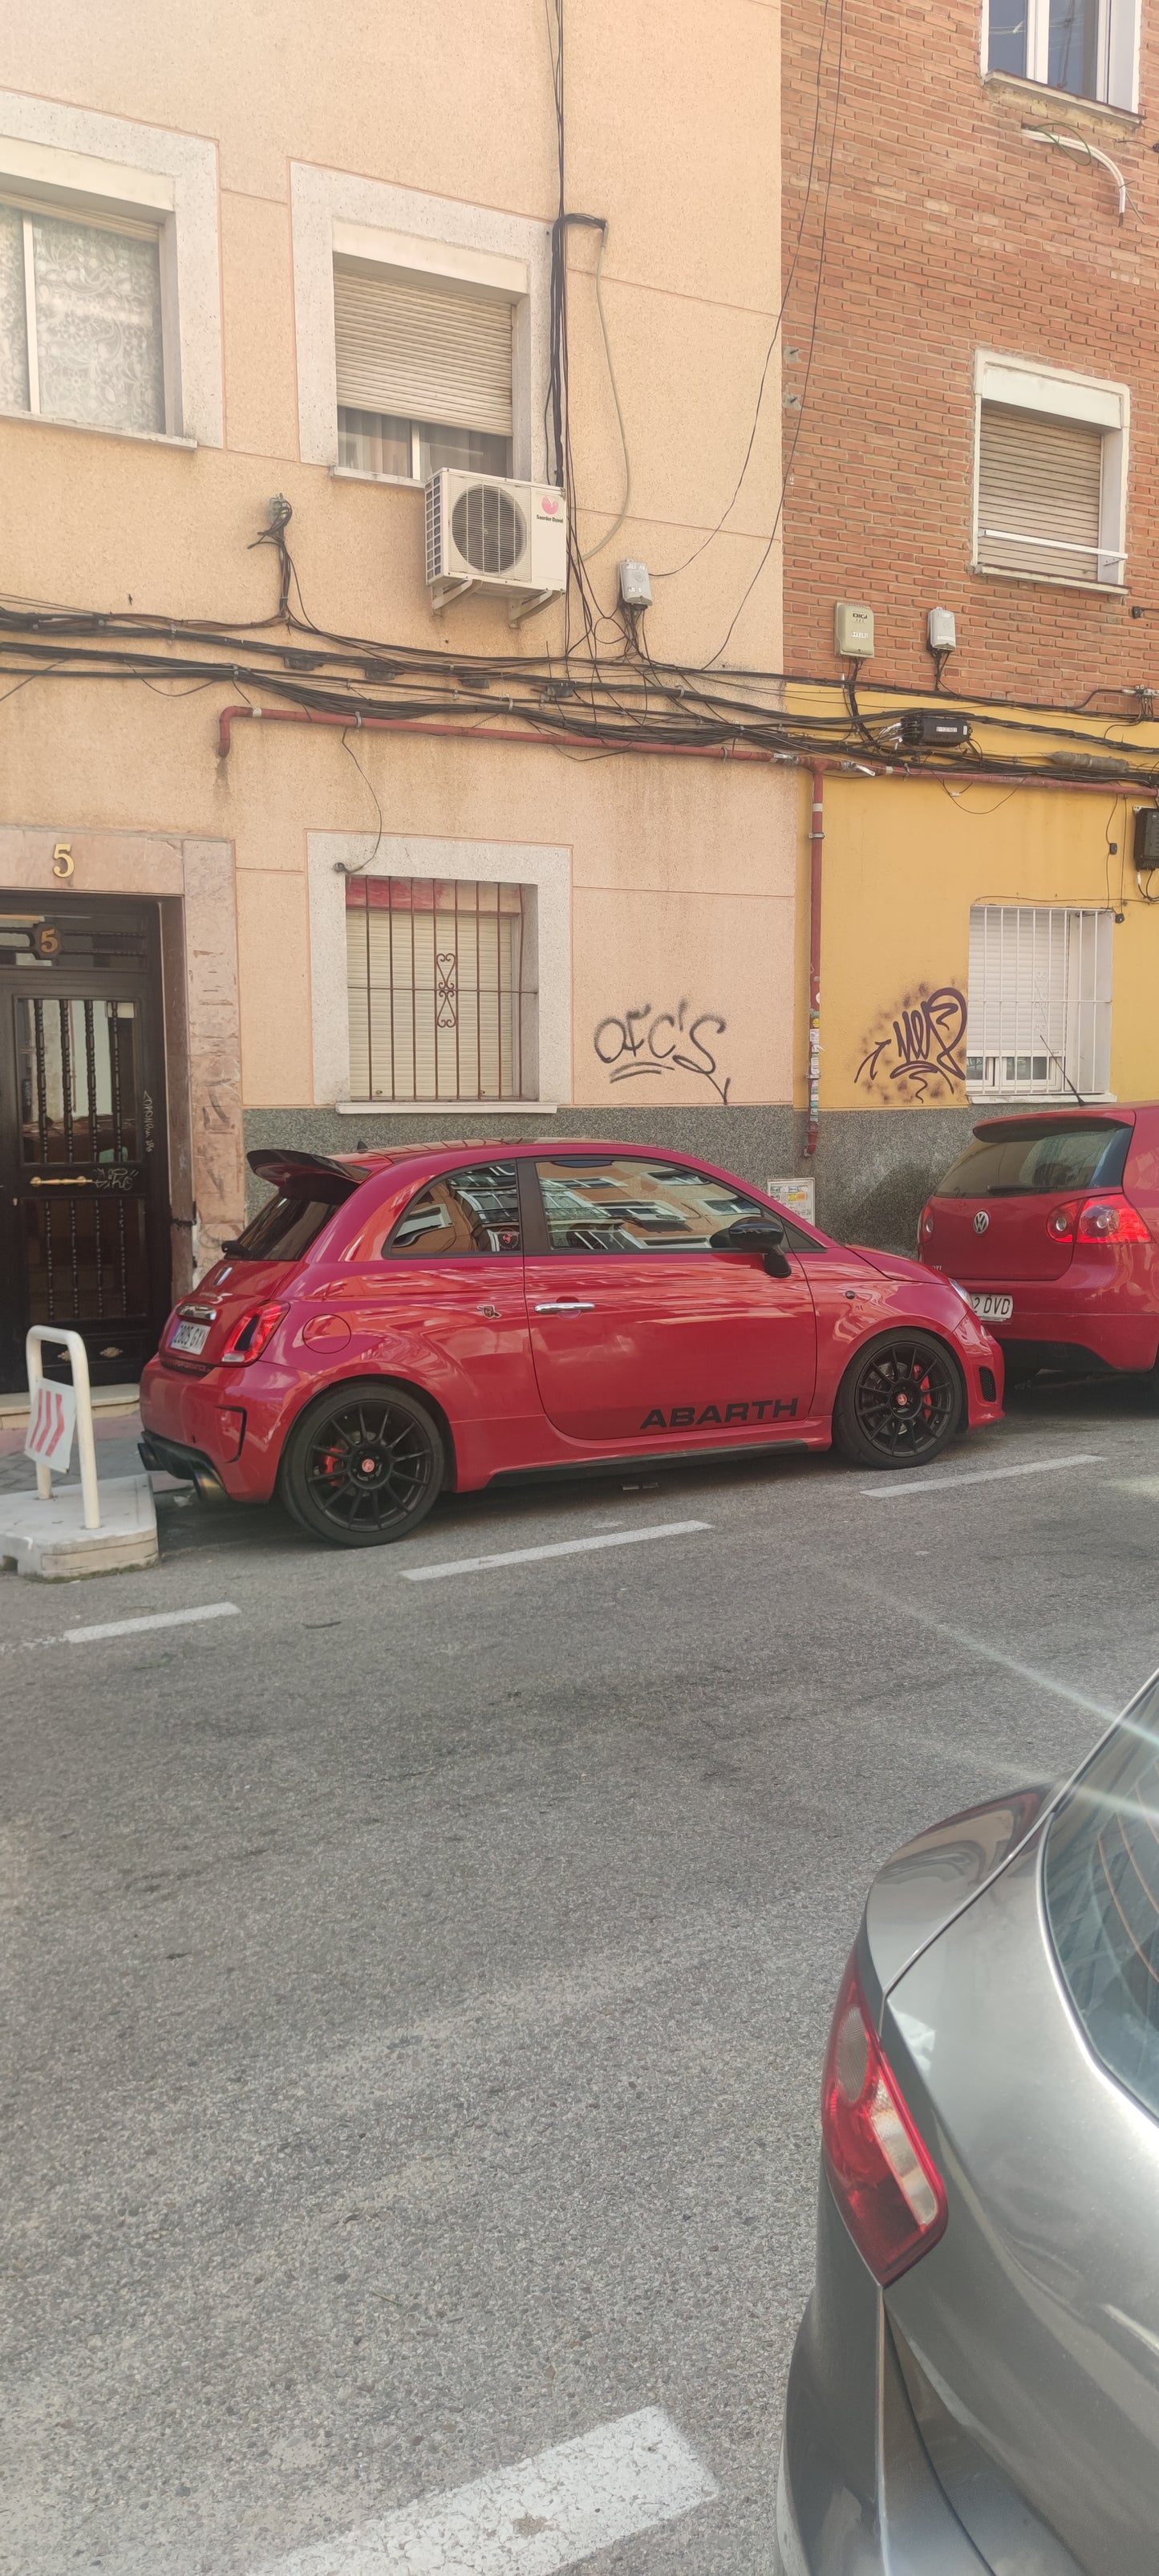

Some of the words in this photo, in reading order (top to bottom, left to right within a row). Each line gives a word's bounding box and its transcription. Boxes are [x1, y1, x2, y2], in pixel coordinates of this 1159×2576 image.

[53, 843, 75, 878] 5
[41, 928, 59, 952] 5
[974, 1211, 989, 1234] VW
[983, 1297, 1011, 1315] DVD
[640, 1398, 798, 1429] ABARTH
